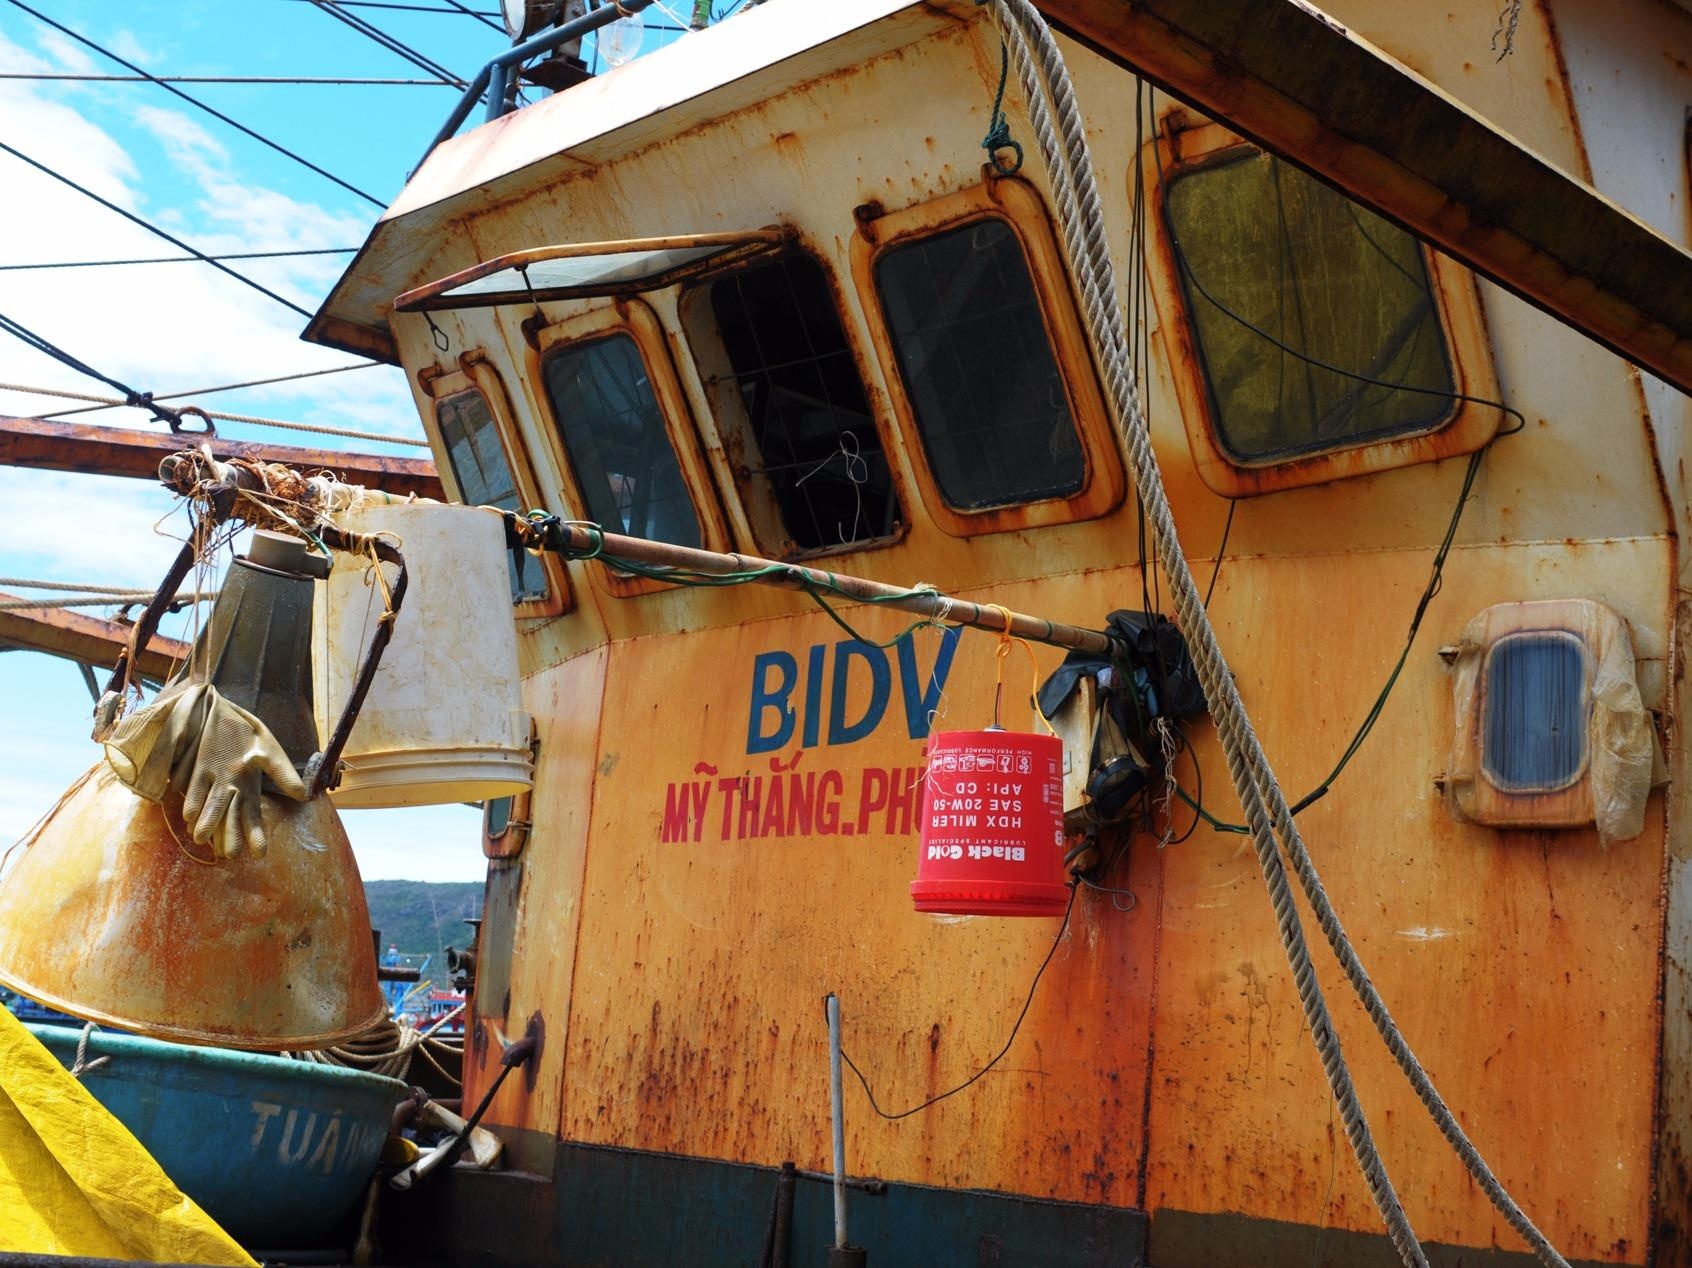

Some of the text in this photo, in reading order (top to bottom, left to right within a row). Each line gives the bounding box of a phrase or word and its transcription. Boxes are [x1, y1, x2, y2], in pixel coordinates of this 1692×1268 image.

[746, 626, 964, 755] BIDV
[965, 747, 1013, 755] PERFORMANCE
[956, 782, 1022, 795] API: CD
[661, 762, 719, 843] MỸ
[933, 799, 1022, 812] SAE 20W-50
[932, 815, 1022, 828] HDX MILER
[976, 838, 1026, 846] LUBRICANT
[928, 845, 1025, 861] Black Gold
